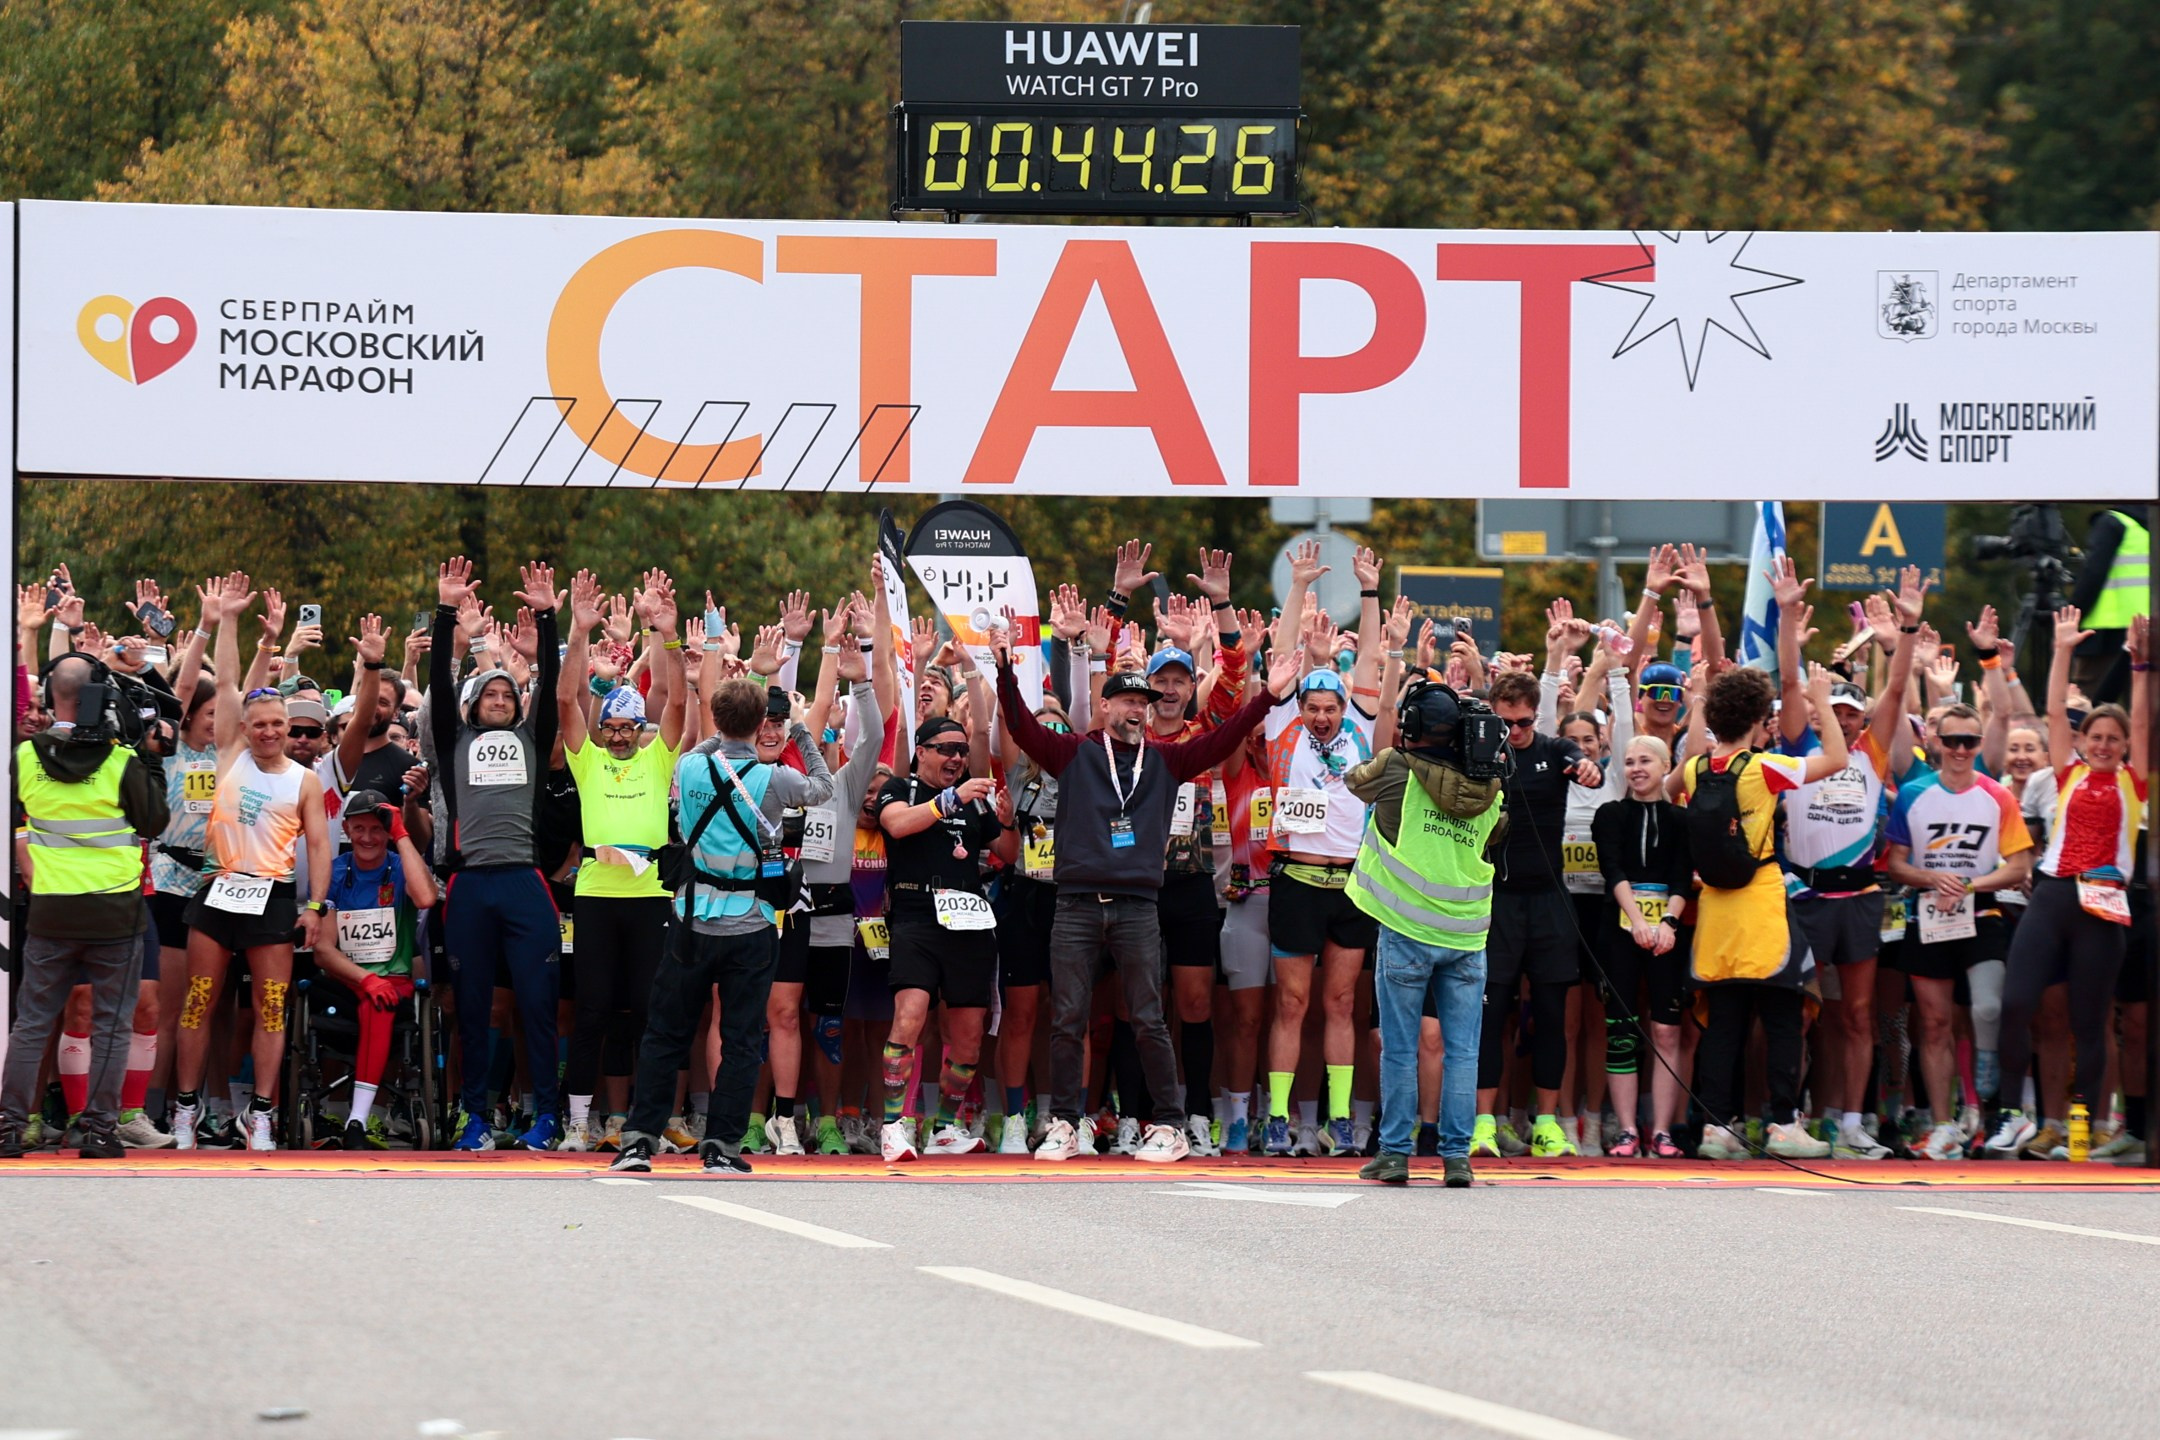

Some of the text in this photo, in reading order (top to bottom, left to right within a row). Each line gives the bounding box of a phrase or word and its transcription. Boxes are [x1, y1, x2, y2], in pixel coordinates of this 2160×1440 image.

[1005, 30, 1199, 66] HUAWEI
[1006, 74, 1199, 98] WATCH GT 7 Pro
[1952, 272, 2079, 291] Департамент
[219, 298, 415, 324] СБЕРПРАЙМ
[1952, 297, 2018, 314] спорта
[1952, 319, 2098, 338] города Москвы
[219, 328, 485, 362] МОСКОВСКИЙ
[547, 229, 1655, 488] СТАРТ
[219, 364, 415, 395] МАРАФОН
[1940, 396, 2097, 430] МОСКОВСКИЙ
[1940, 434, 2013, 462] СПОРТ
[477, 745, 518, 762] 6962
[240, 786, 272, 801] Golden
[242, 794, 263, 807] Ring
[1808, 812, 1834, 823] ОДНА
[1838, 816, 1864, 825] ЦЕЛЬ
[217, 883, 268, 899] 16070
[938, 897, 989, 913] 20320
[341, 922, 394, 941] 14254
